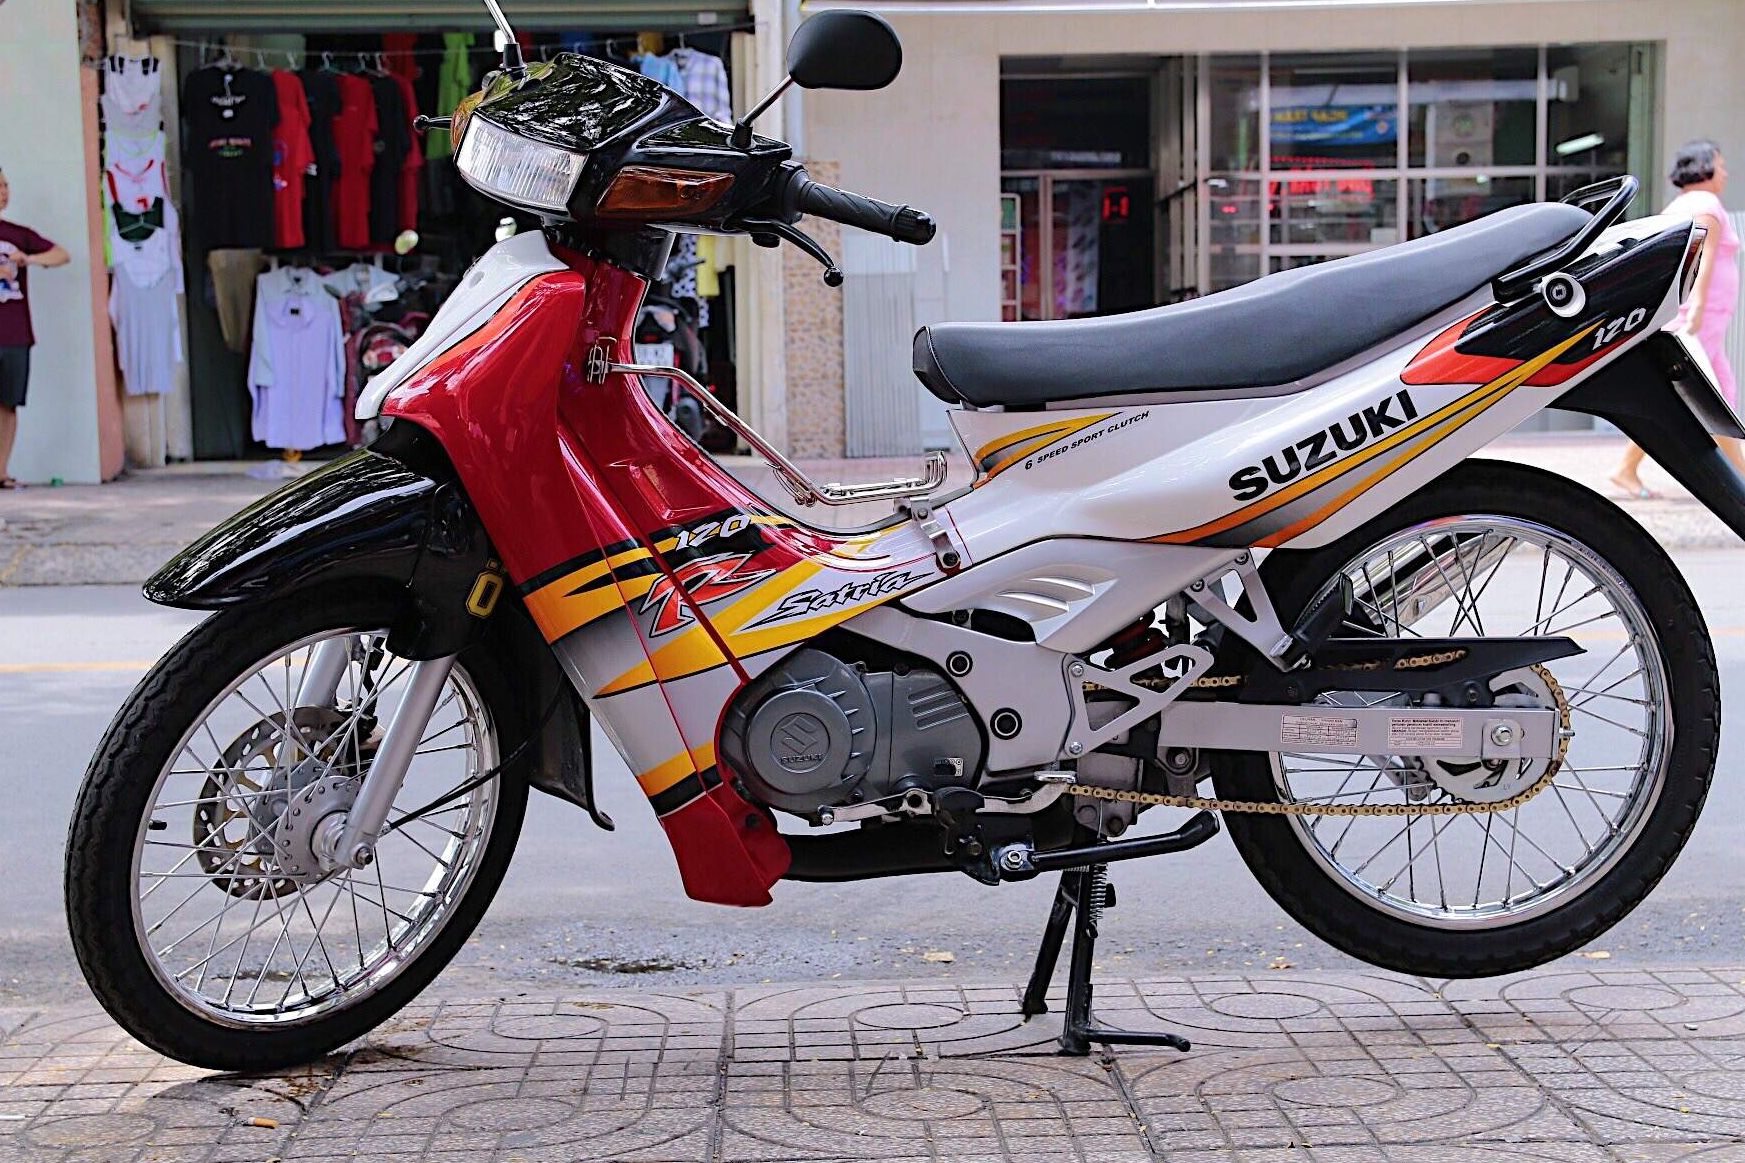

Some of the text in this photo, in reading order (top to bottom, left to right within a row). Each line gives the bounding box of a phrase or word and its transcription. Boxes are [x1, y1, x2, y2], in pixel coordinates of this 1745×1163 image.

[1592, 306, 1647, 351] 120
[1024, 410, 1150, 471] 6 SPEED SPORT CLUTCH
[1227, 388, 1419, 502] SUZUKI
[673, 513, 752, 551] 120
[739, 571, 935, 632] Satria
[780, 753, 826, 765] SUZUKI
